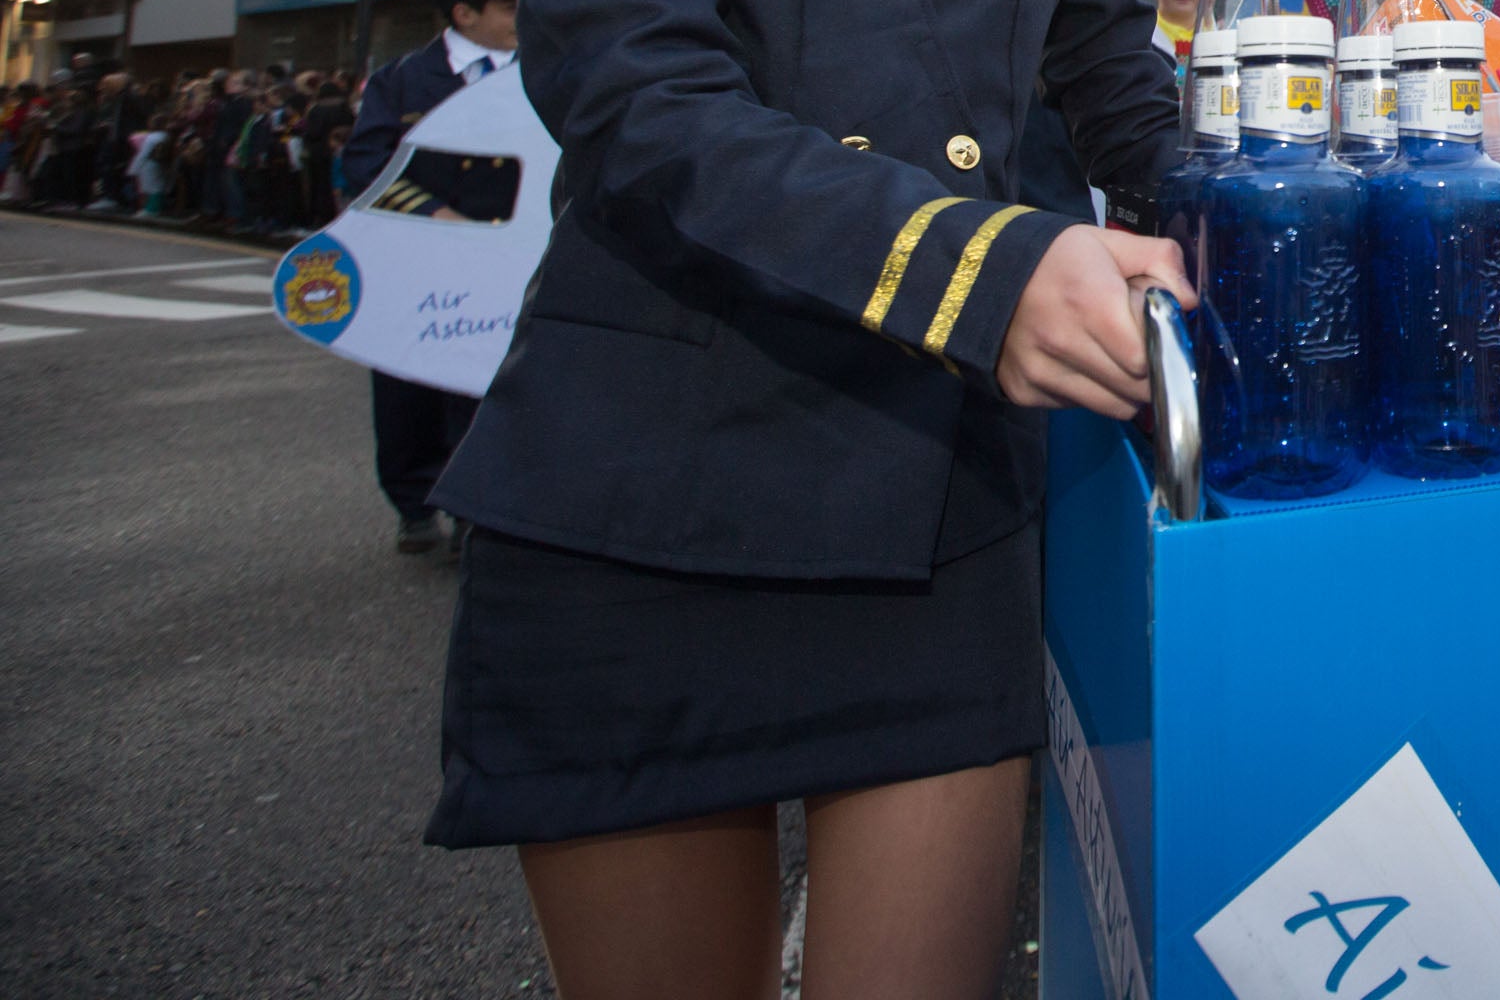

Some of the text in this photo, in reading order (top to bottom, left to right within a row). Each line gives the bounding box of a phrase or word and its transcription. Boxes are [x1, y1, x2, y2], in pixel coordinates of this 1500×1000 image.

[417, 290, 471, 314] Air
[419, 311, 516, 342] Asturi
[1283, 889, 1452, 1000] Ai
